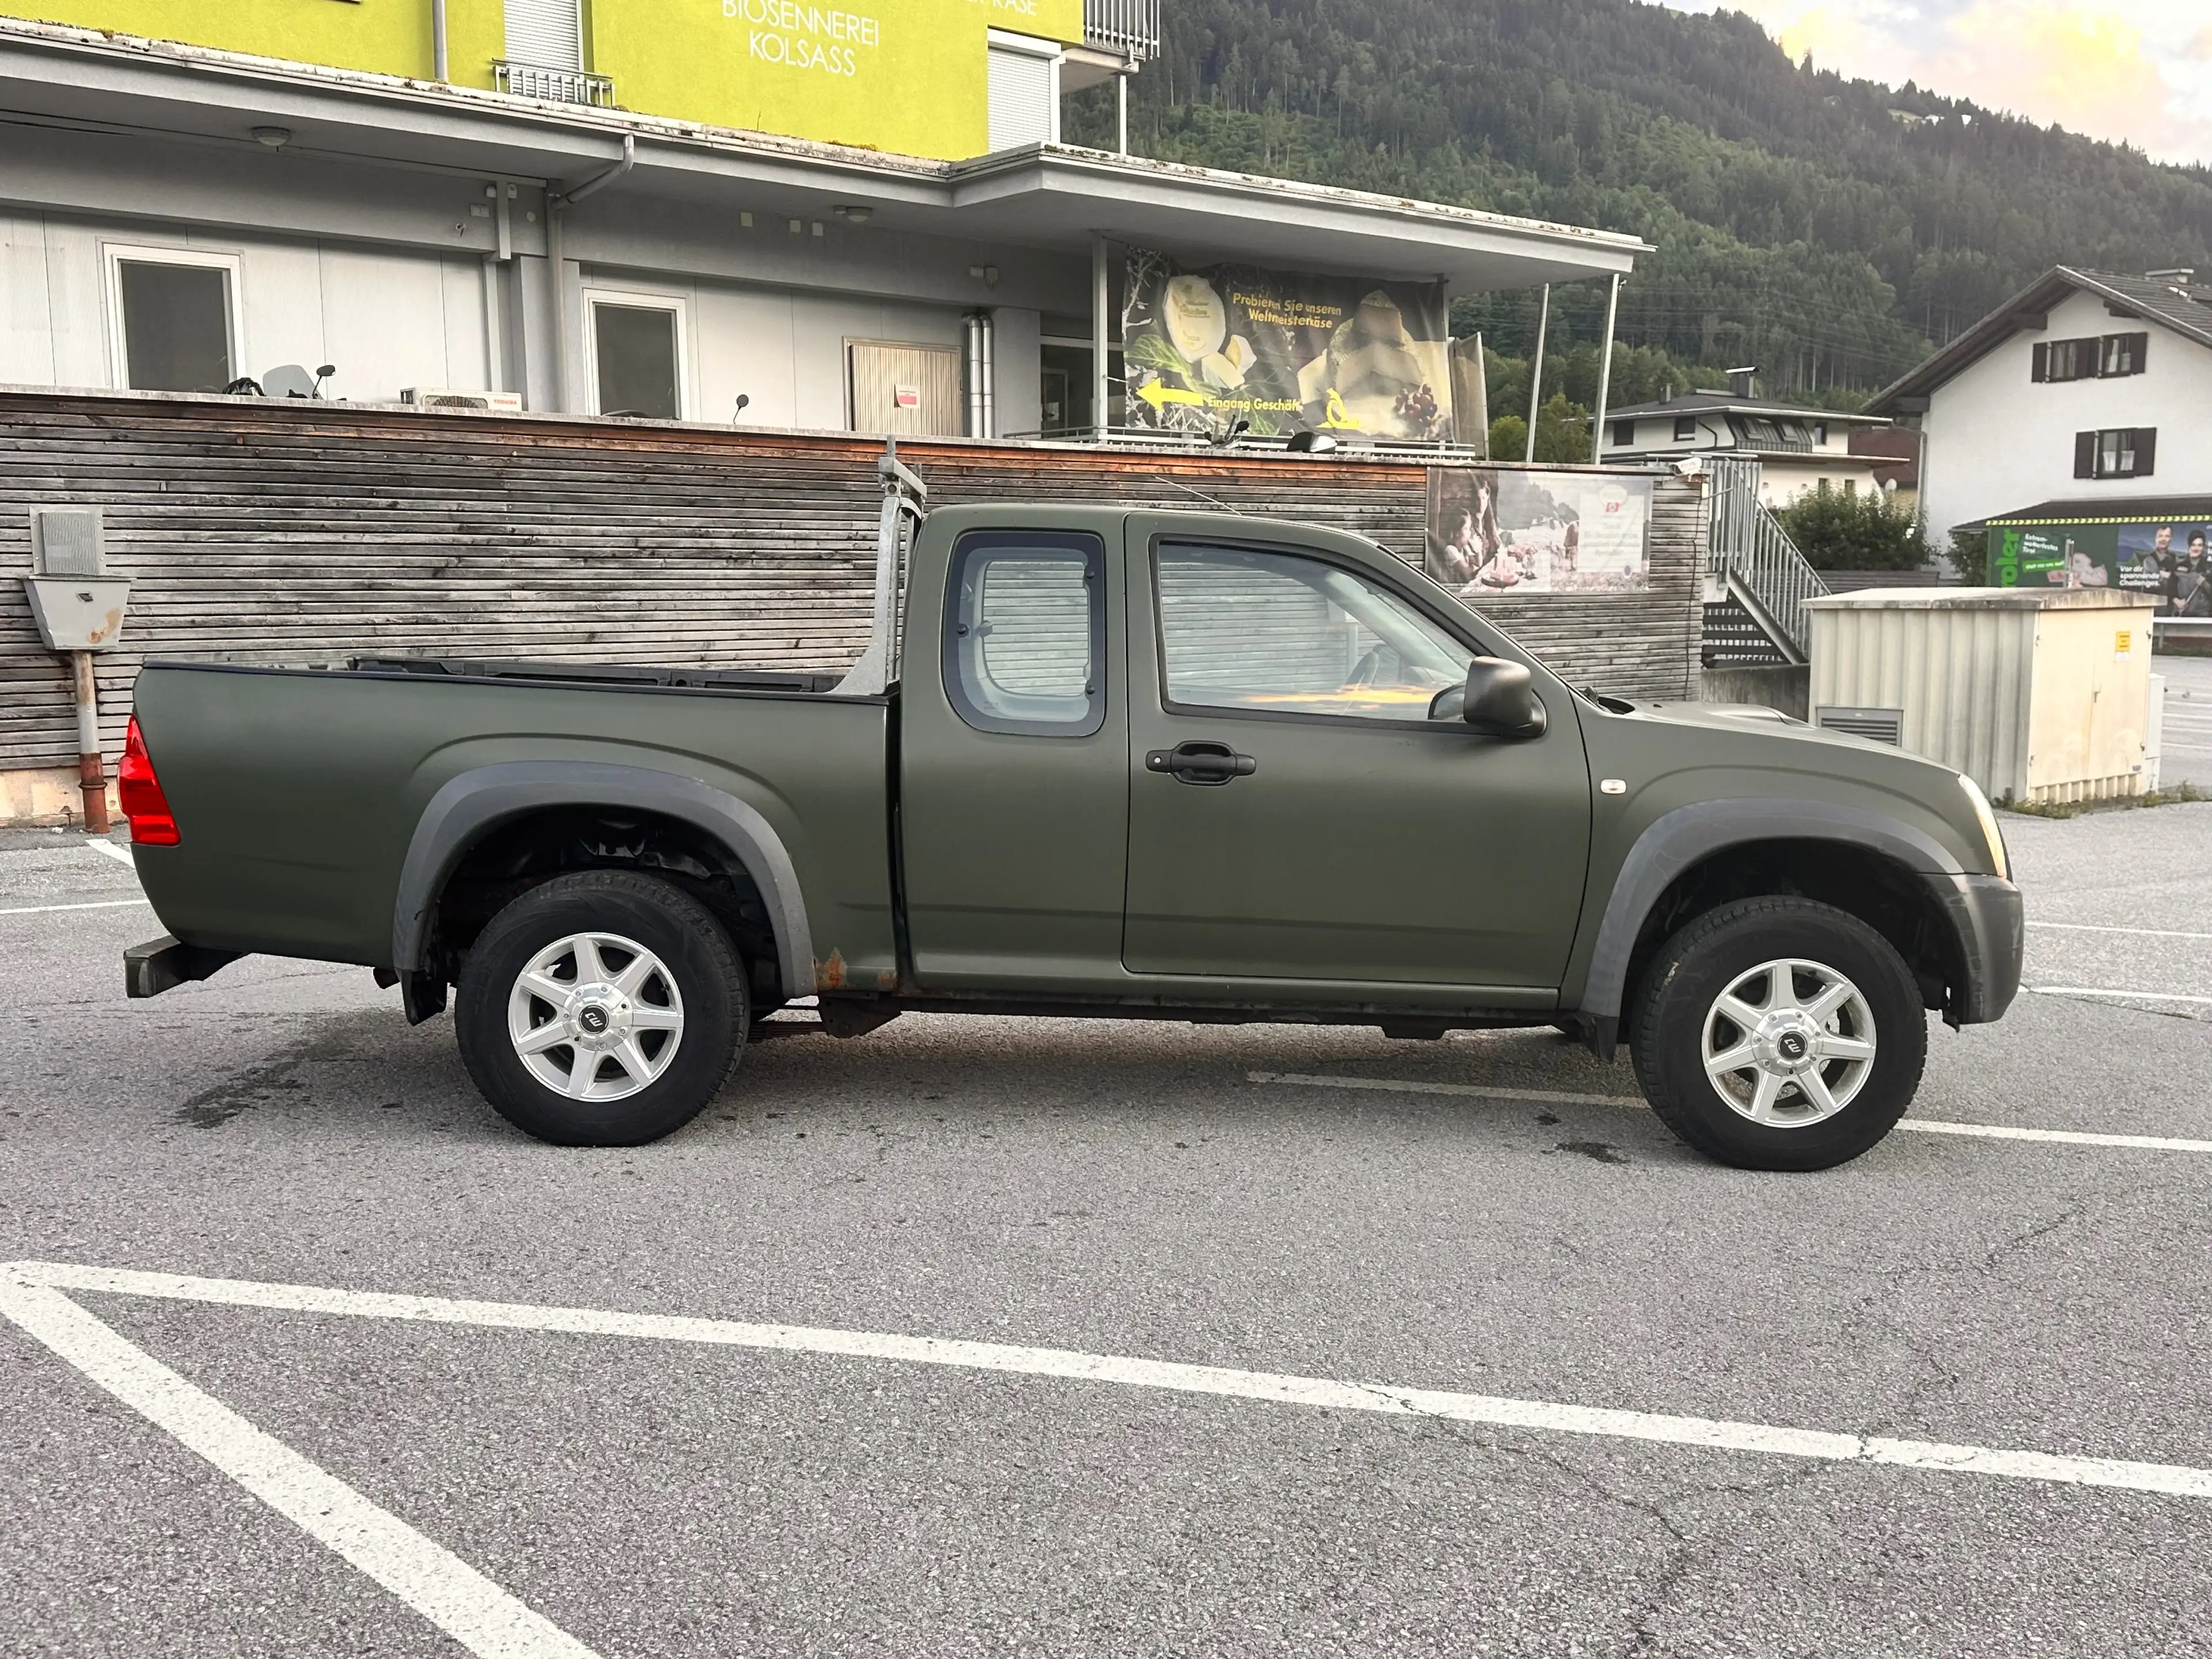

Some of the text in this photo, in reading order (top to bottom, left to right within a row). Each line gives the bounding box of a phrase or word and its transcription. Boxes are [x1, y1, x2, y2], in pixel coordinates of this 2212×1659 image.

[722, 0, 878, 46] BIOSENNEREI
[749, 29, 856, 76] KOLSASS
[1233, 293, 1342, 316] Probieren Sie unseren
[1248, 308, 1332, 329] Weltmeisterkäse
[1208, 396, 1301, 412] Eingang Geschäft
